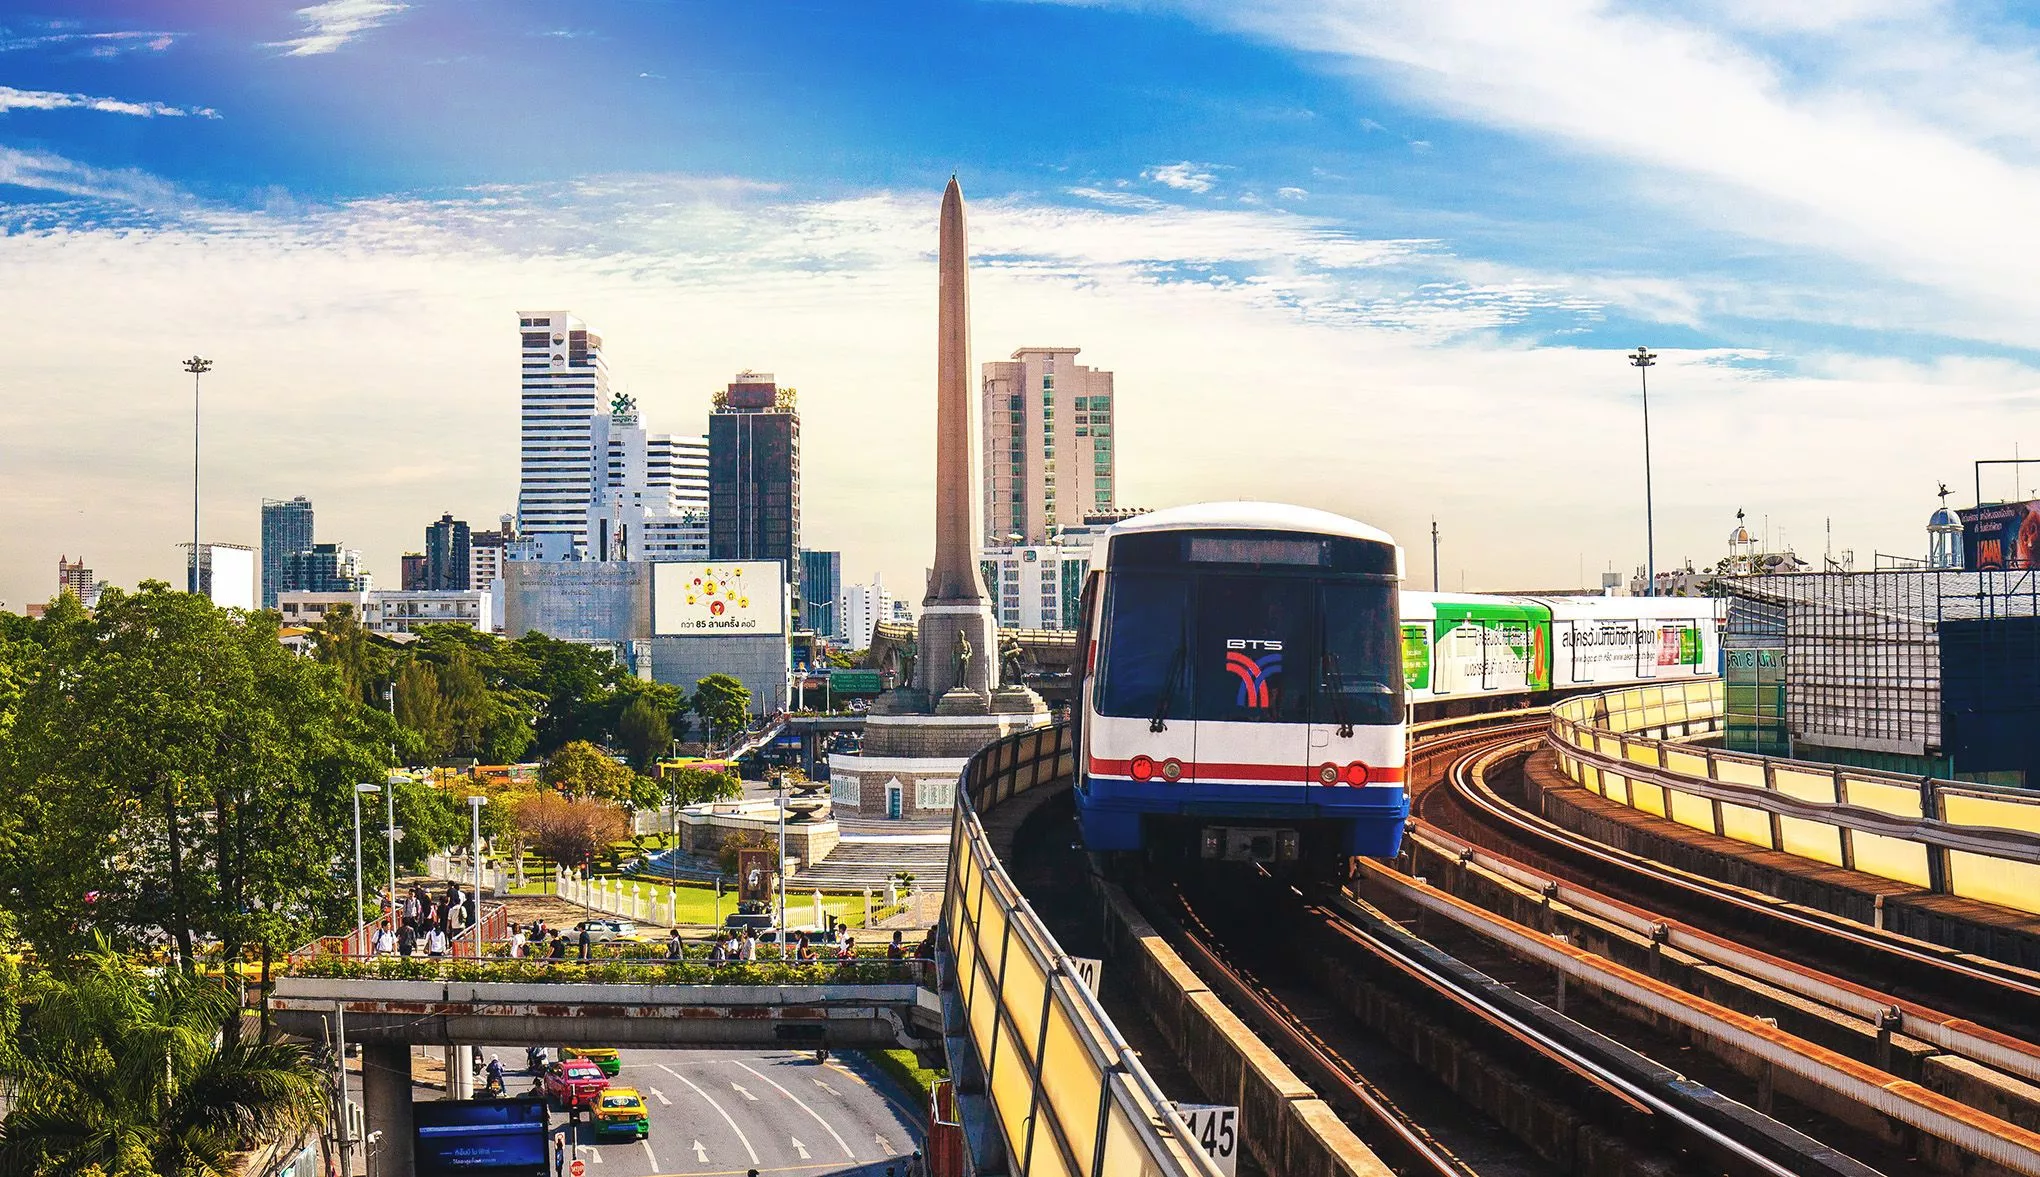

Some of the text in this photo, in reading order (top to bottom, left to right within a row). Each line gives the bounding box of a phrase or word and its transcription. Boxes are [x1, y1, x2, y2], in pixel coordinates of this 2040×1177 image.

[680, 617, 695, 628] กว่า
[695, 620, 707, 628] 85
[708, 616, 740, 628] ล้านครั้ง
[1226, 639, 1283, 651] BTS
[1187, 1111, 1235, 1158] 145
